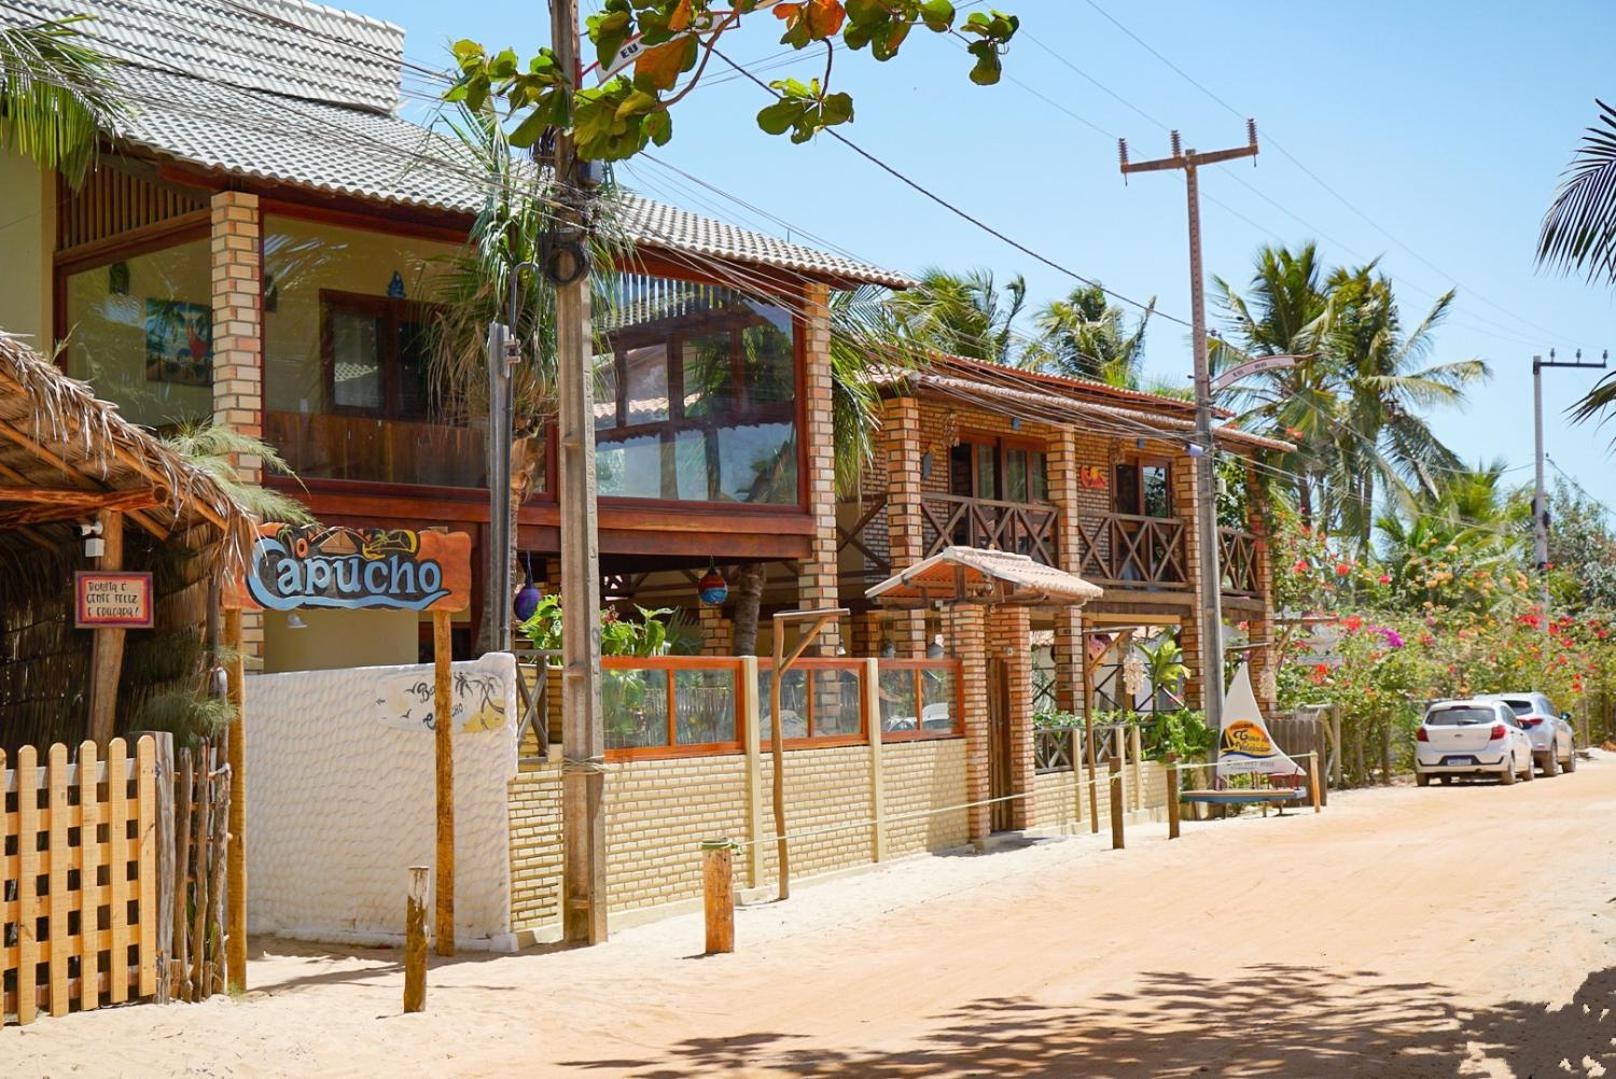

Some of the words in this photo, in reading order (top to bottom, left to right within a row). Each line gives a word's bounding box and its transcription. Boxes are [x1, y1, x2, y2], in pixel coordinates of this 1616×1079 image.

[620, 43, 638, 59] EU
[249, 537, 445, 610] Capucho
[114, 593, 138, 604] FELIZ
